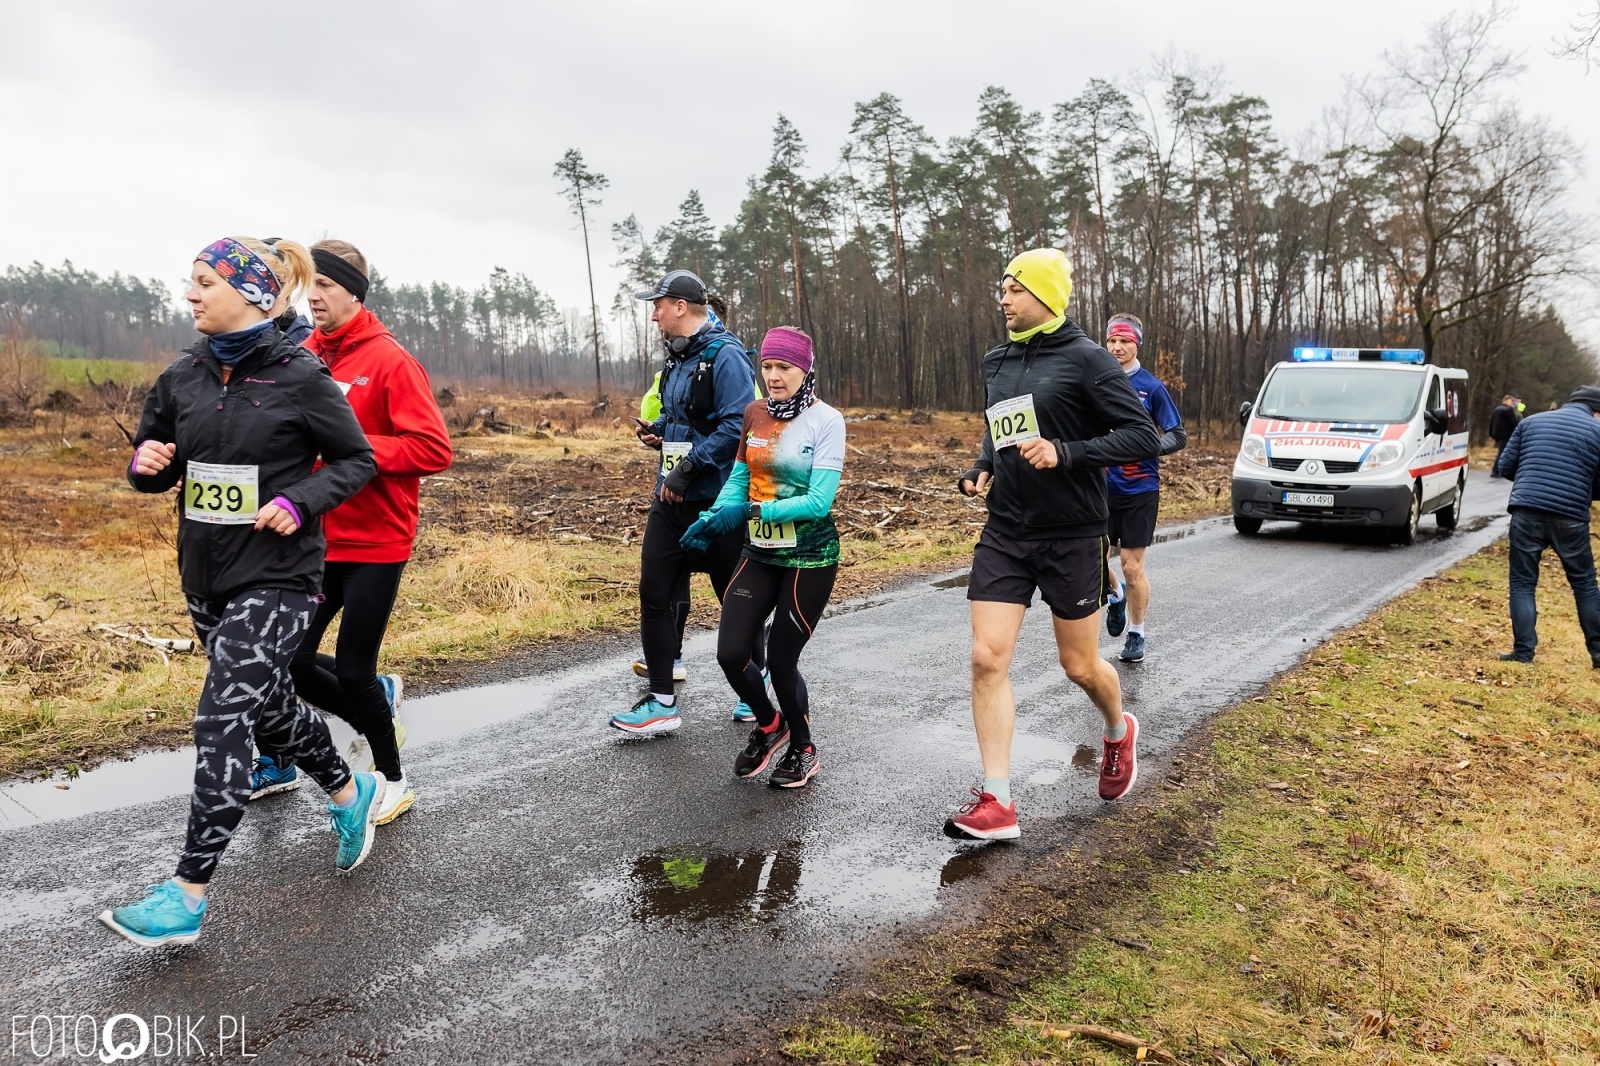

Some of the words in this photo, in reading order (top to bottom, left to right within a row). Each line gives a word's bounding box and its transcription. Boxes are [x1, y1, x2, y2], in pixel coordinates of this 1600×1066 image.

[994, 412, 1028, 441] 202
[192, 482, 243, 513] 239
[1287, 493, 1303, 503] SBL
[1306, 495, 1333, 505] 61490
[754, 521, 785, 540] 201
